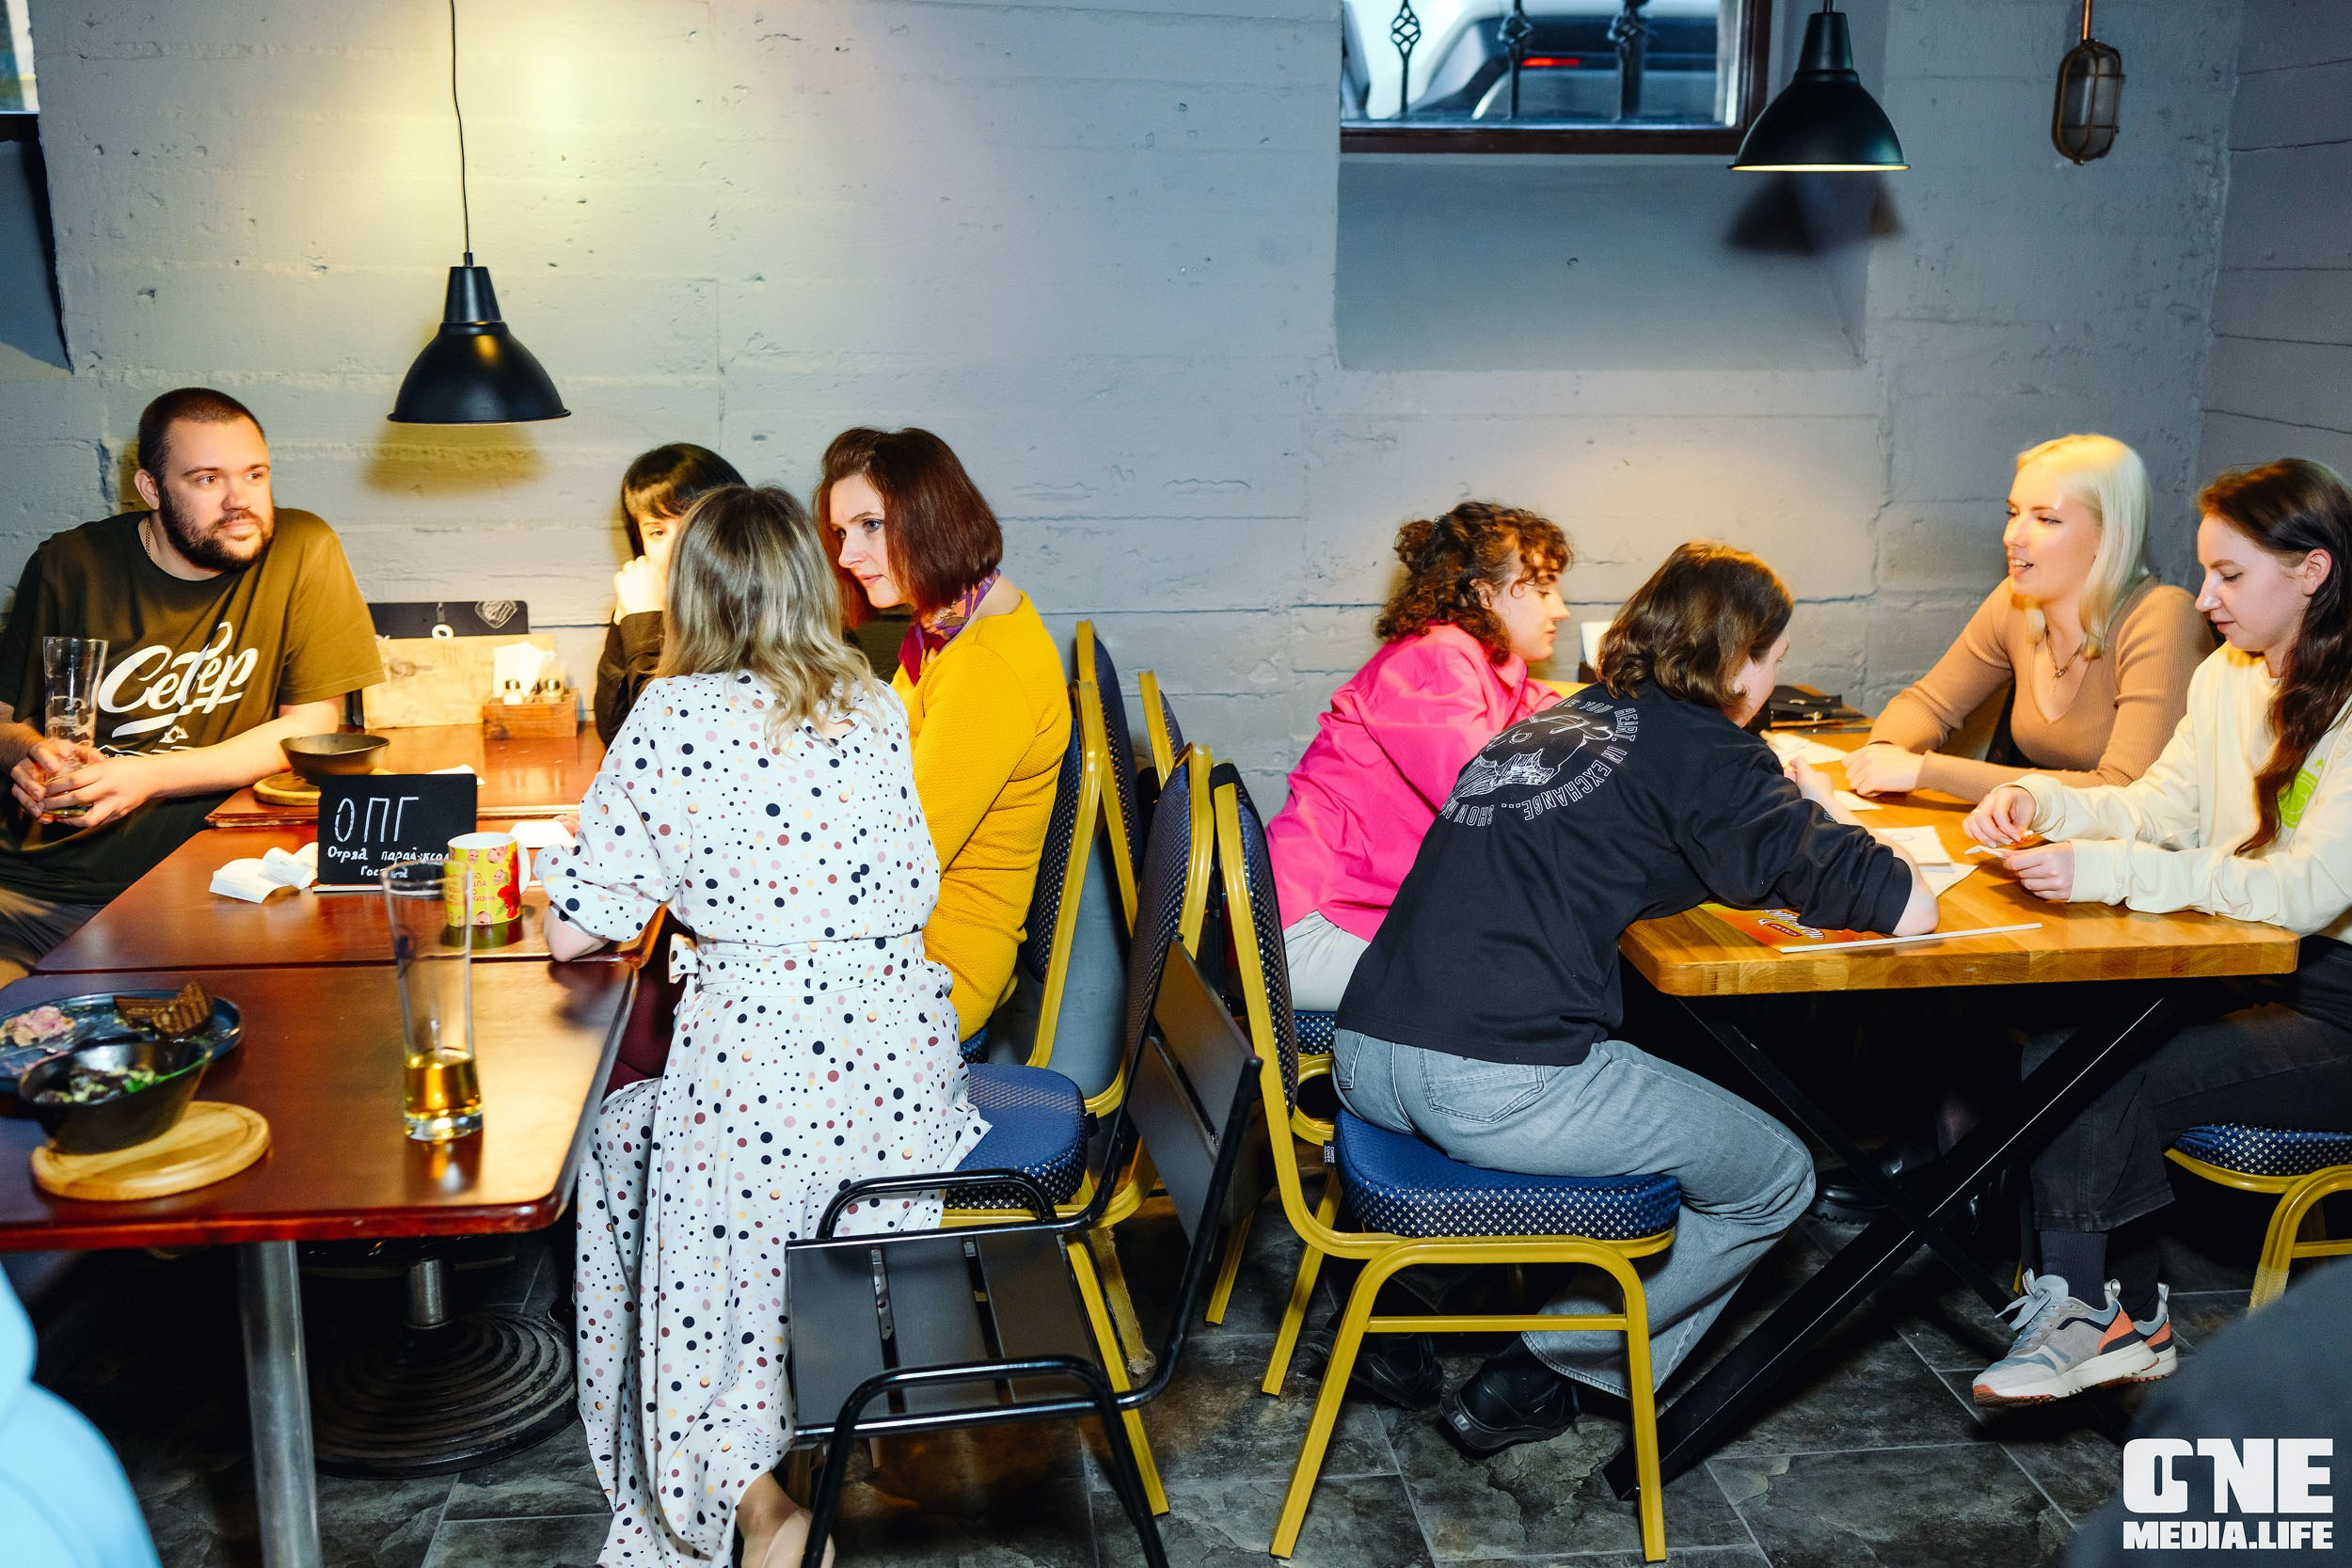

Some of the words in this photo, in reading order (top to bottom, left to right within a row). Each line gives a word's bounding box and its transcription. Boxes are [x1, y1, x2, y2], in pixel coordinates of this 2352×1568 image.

[1600, 745, 1628, 765] IN
[334, 796, 420, 843] ОПГ
[327, 846, 369, 863] Отряд
